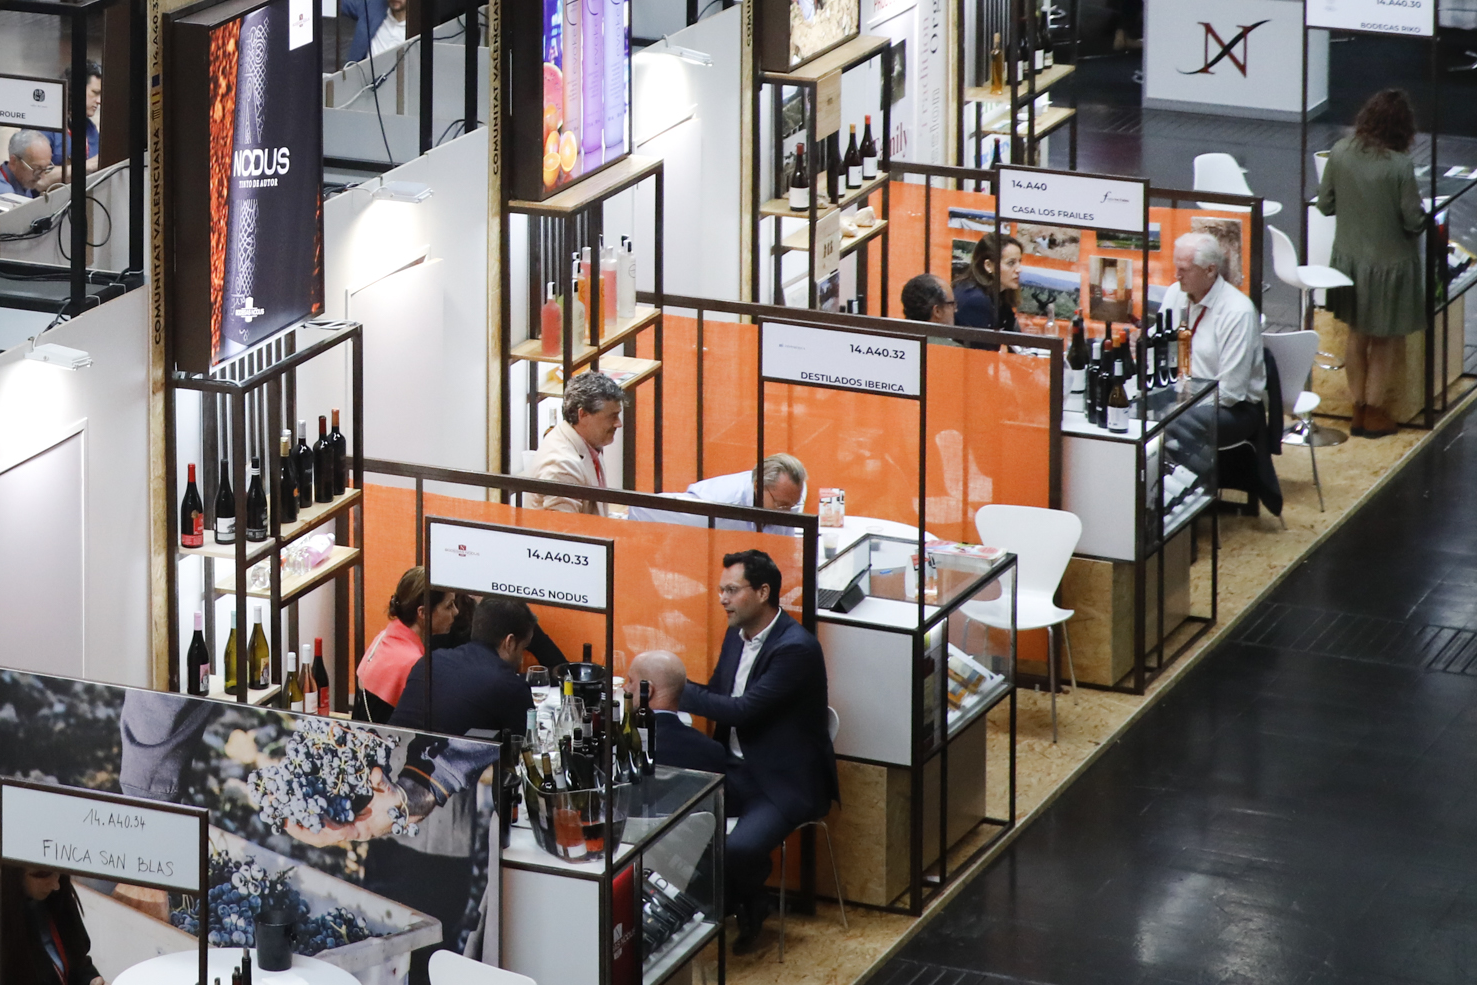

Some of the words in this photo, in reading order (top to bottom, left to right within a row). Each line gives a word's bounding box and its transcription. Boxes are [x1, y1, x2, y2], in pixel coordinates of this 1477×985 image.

[1359, 21, 1399, 32] BODEGAS
[1399, 24, 1421, 34] RIKO
[2, 110, 27, 120] ROURE
[492, 87, 500, 175] COMUNITAT
[234, 147, 290, 178] NODUS
[153, 127, 161, 244] VALENCIANA
[261, 178, 279, 187] AUTOR
[1011, 179, 1048, 192] 14.A40
[1011, 204, 1037, 215] CASA
[1038, 207, 1055, 218] LOS
[1057, 209, 1094, 222] FRAILES
[849, 343, 906, 360] 14.A40.32
[800, 370, 863, 386] DESTILADOS
[864, 377, 905, 392] IBERICA
[526, 547, 589, 566] 14.A40.33
[490, 580, 546, 598] BODEGAS
[546, 587, 589, 604] NODUS
[83, 808, 147, 829] 14.A40.34
[41, 839, 91, 866] FINCA
[99, 849, 126, 870] SAN
[137, 855, 174, 877] BLAS
